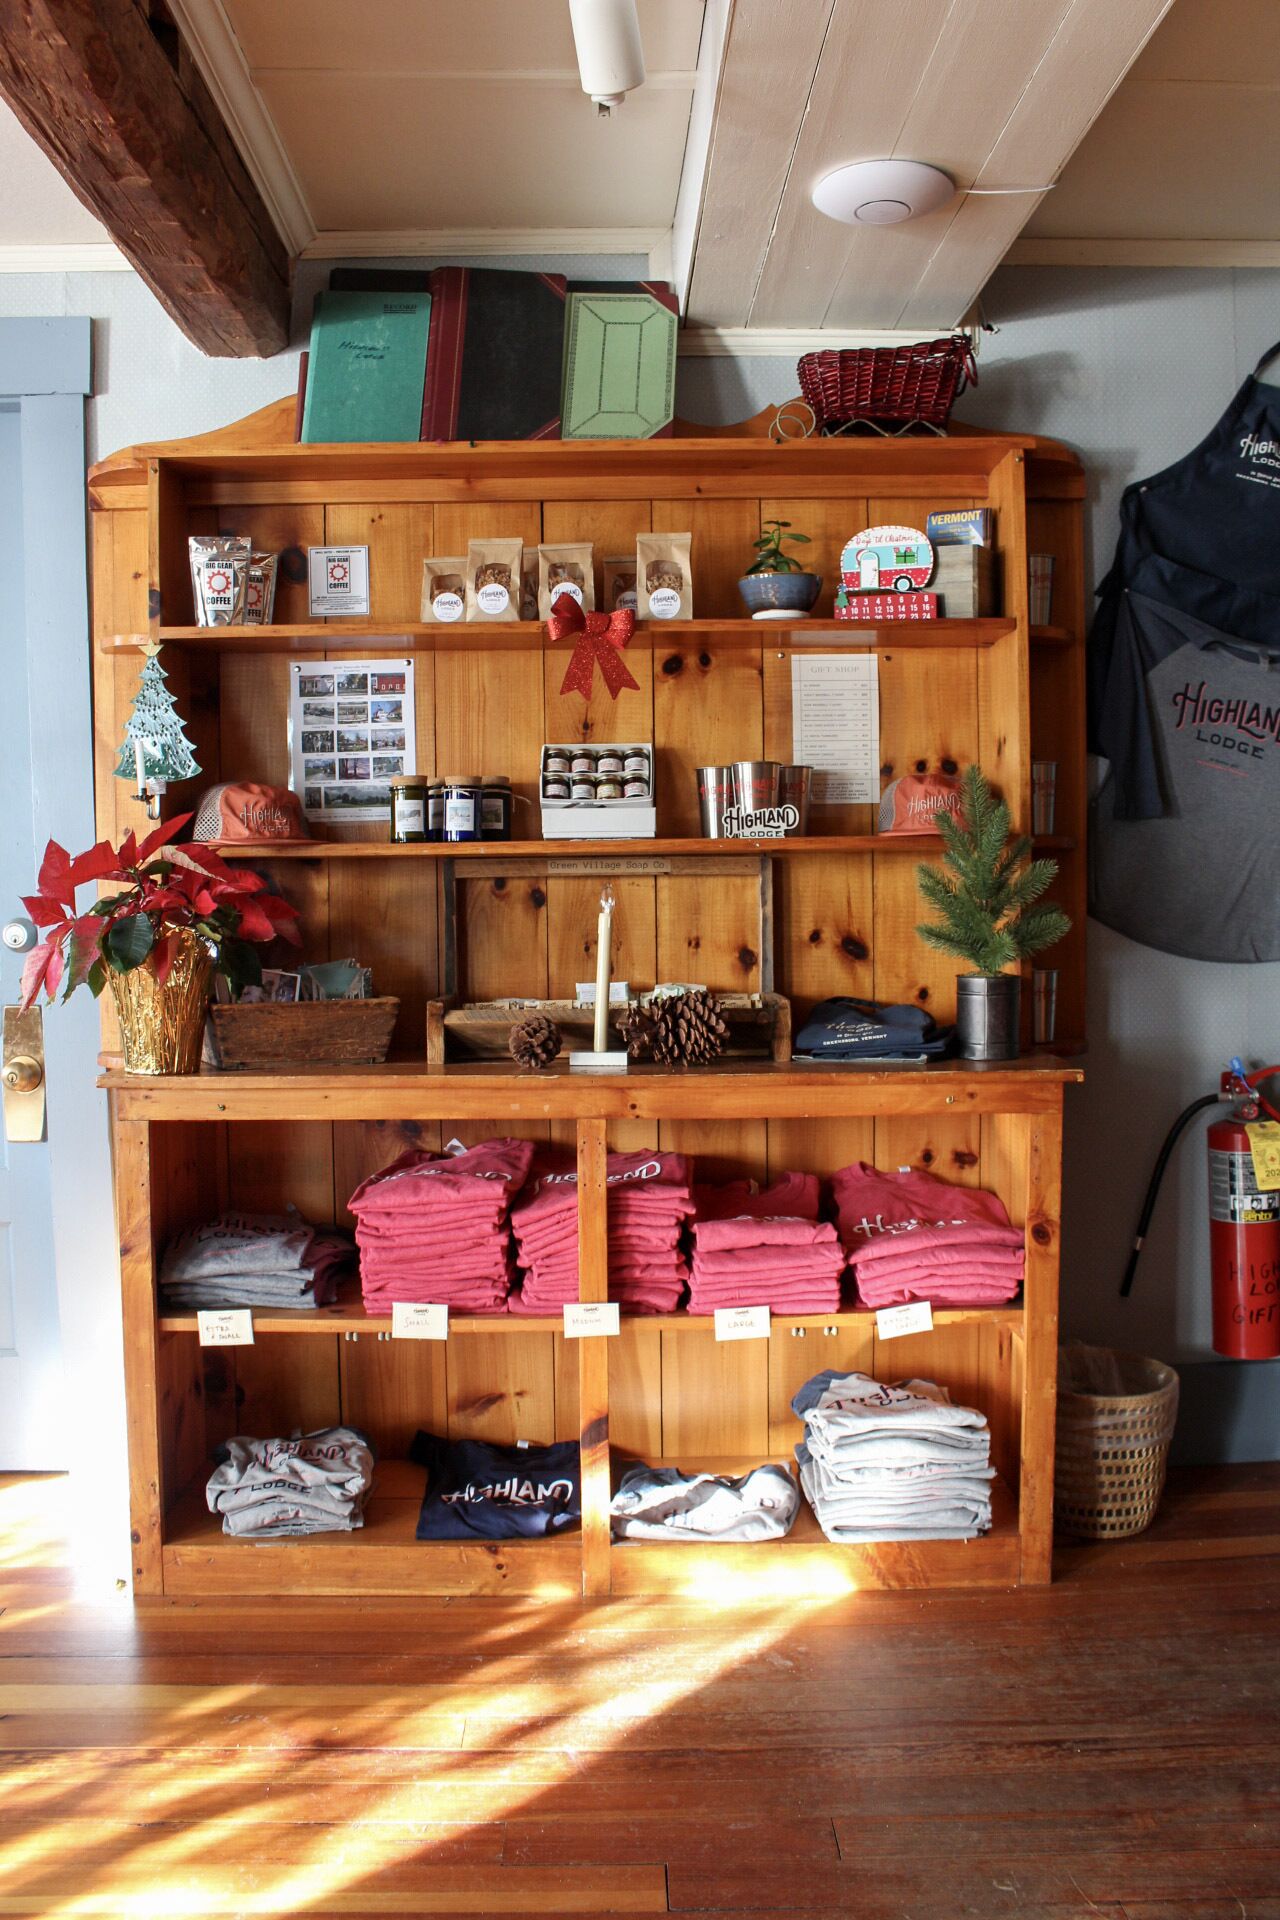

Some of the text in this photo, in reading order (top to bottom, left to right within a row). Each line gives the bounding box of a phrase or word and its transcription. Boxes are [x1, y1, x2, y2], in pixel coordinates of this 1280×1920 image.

[930, 510, 982, 526] VERMONT
[206, 596, 232, 605] COFFEE
[852, 598, 857, 606] 2
[863, 597, 869, 605] 3
[875, 597, 881, 605] 4
[887, 596, 892, 604] 5
[899, 595, 904, 603] 6
[923, 594, 929, 602] 8
[248, 608, 262, 617] FFEE
[851, 607, 859, 615] 10
[874, 606, 882, 614] 12
[886, 605, 894, 613] 13
[922, 603, 930, 611] 16
[834, 665, 860, 673] SHOP
[1196, 729, 1265, 760] LODGE
[239, 800, 287, 828] HIGHLA
[723, 805, 798, 836] HIGHLAND
[741, 830, 785, 838] LODGE
[550, 861, 578, 870] Green
[582, 860, 622, 870] Village
[626, 860, 649, 870] Soap
[1249, 1282, 1280, 1296] LO
[1232, 1303, 1278, 1325] GIFT
[250, 1480, 313, 1494] LODGE
